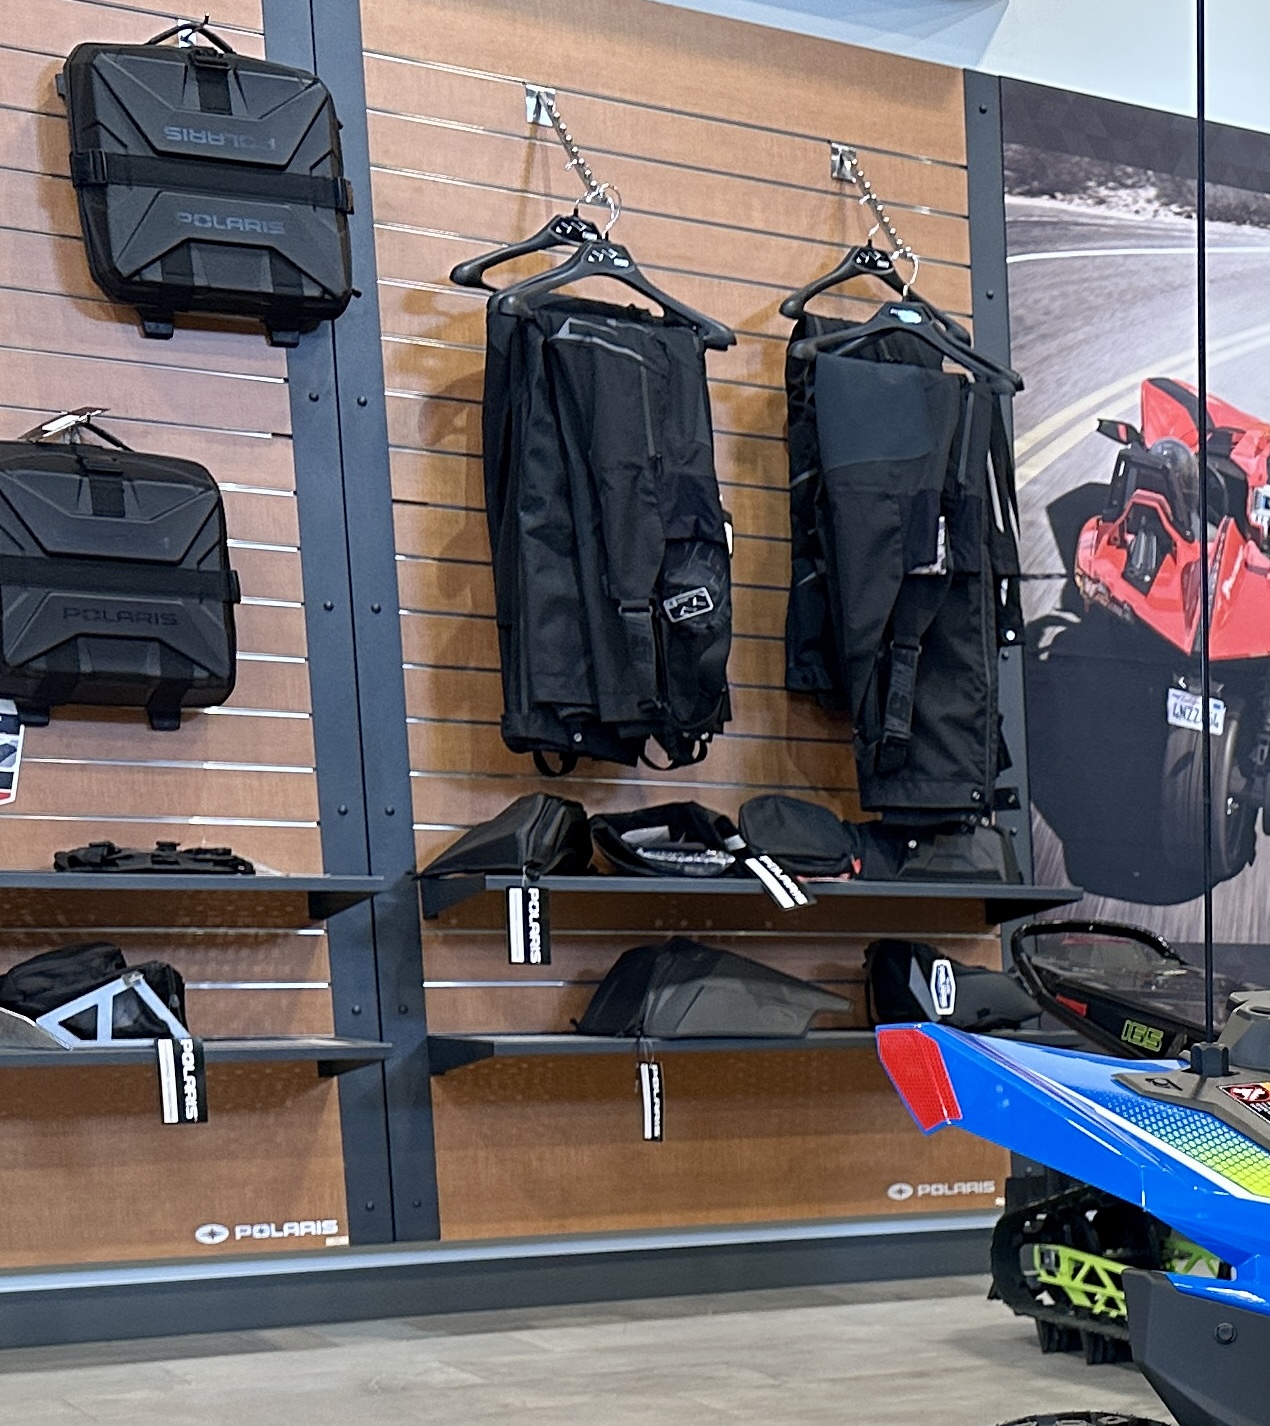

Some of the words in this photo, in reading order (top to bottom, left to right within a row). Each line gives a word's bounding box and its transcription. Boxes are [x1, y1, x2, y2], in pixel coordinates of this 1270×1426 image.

[163, 126, 276, 150] OLARIS
[176, 211, 286, 235] POLARIS
[63, 607, 178, 626] POLARIS
[528, 887, 542, 964] POLARIS
[180, 1038, 198, 1123] POLARIS
[917, 1180, 996, 1198] POLARIS
[235, 1219, 339, 1241] POLARIS
